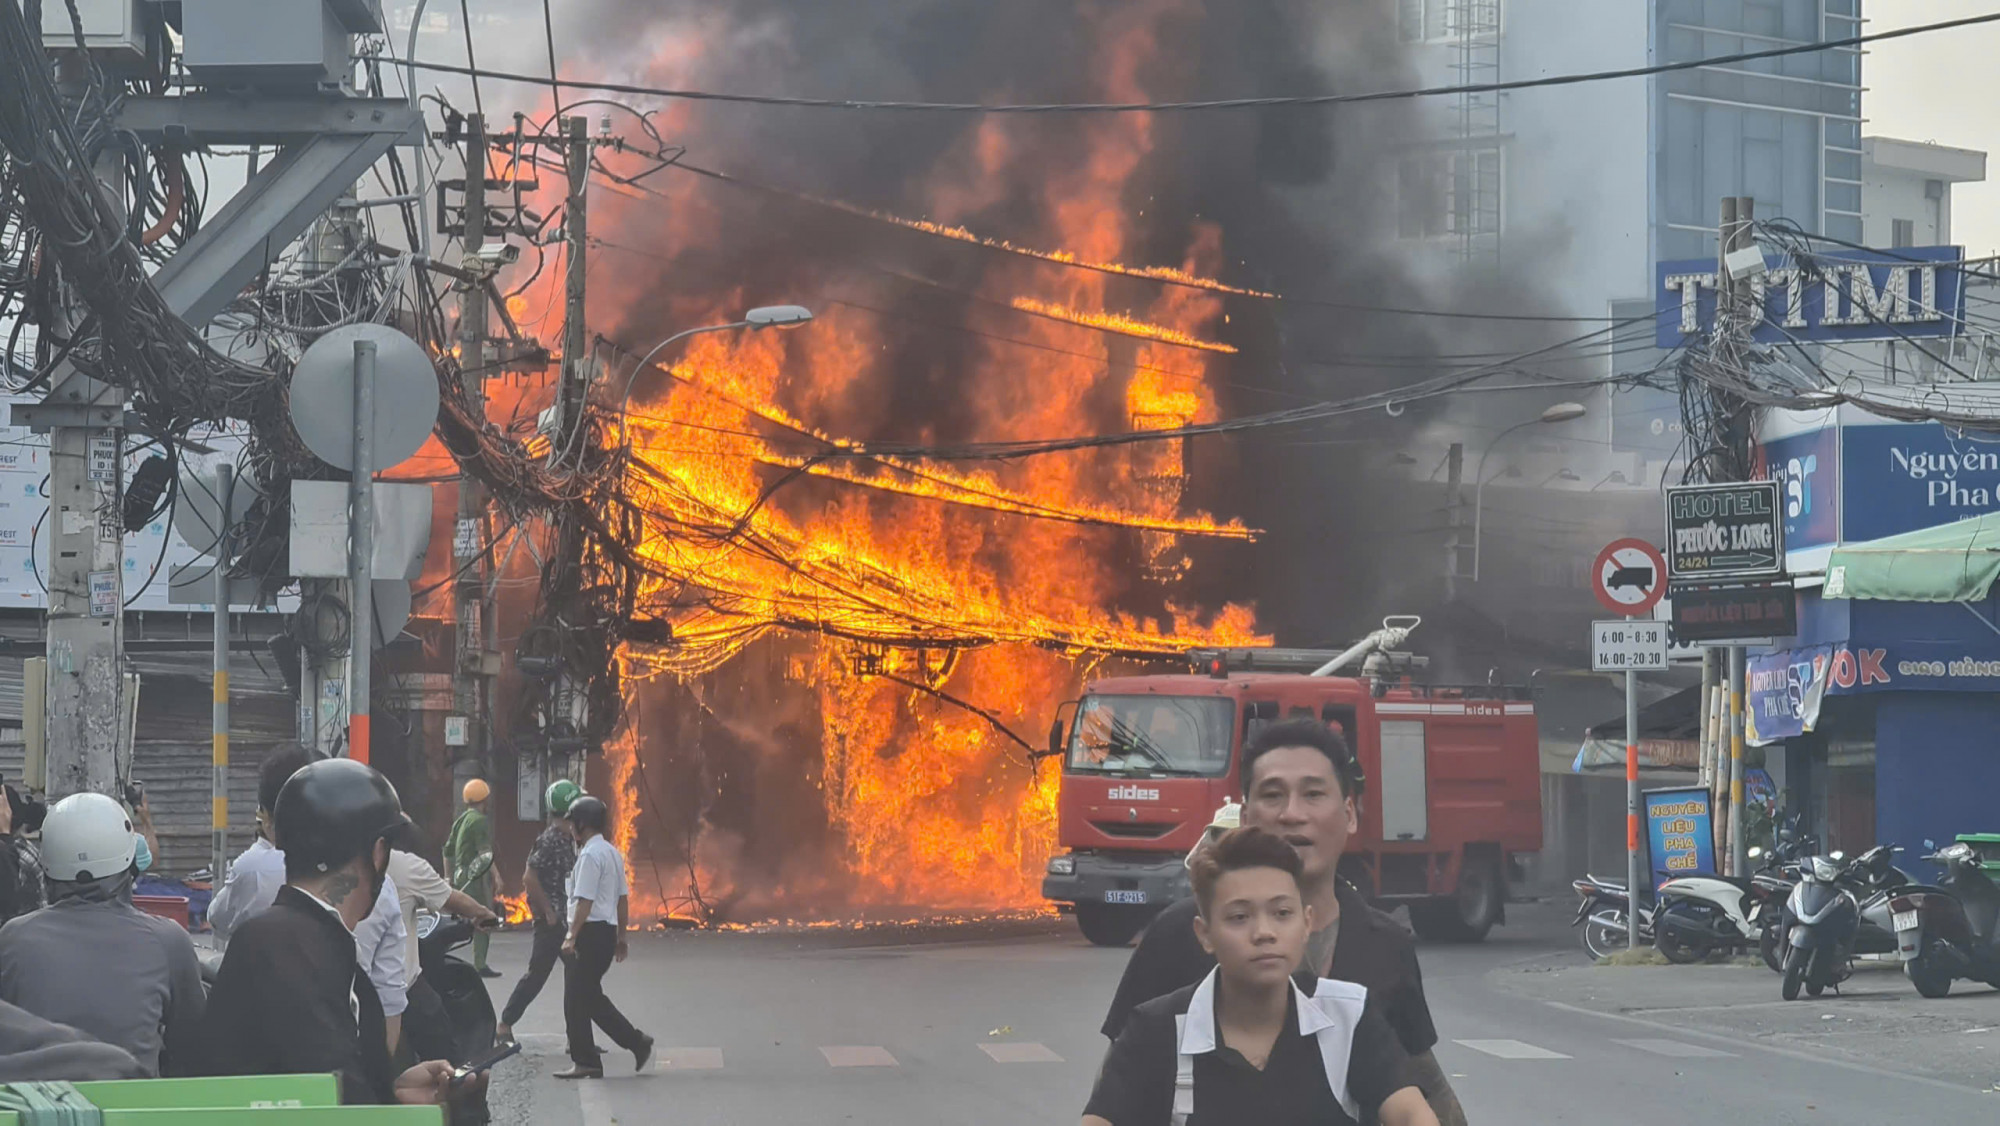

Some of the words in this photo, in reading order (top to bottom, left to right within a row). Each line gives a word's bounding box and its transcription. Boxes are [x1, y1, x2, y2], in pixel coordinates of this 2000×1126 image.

[1890, 446, 1997, 479] Nguyên
[1928, 480, 1989, 507] Pha
[1673, 491, 1771, 519] HOTEL
[1730, 523, 1772, 550] LONG
[1678, 556, 1709, 569] 24/24
[1635, 631, 1657, 643] 8:30
[1898, 660, 1945, 677] GIAO
[1466, 704, 1501, 716] sides
[1108, 784, 1160, 801] sides
[1650, 801, 1707, 818] NGUYÊN
[1664, 838, 1696, 851] PHA
